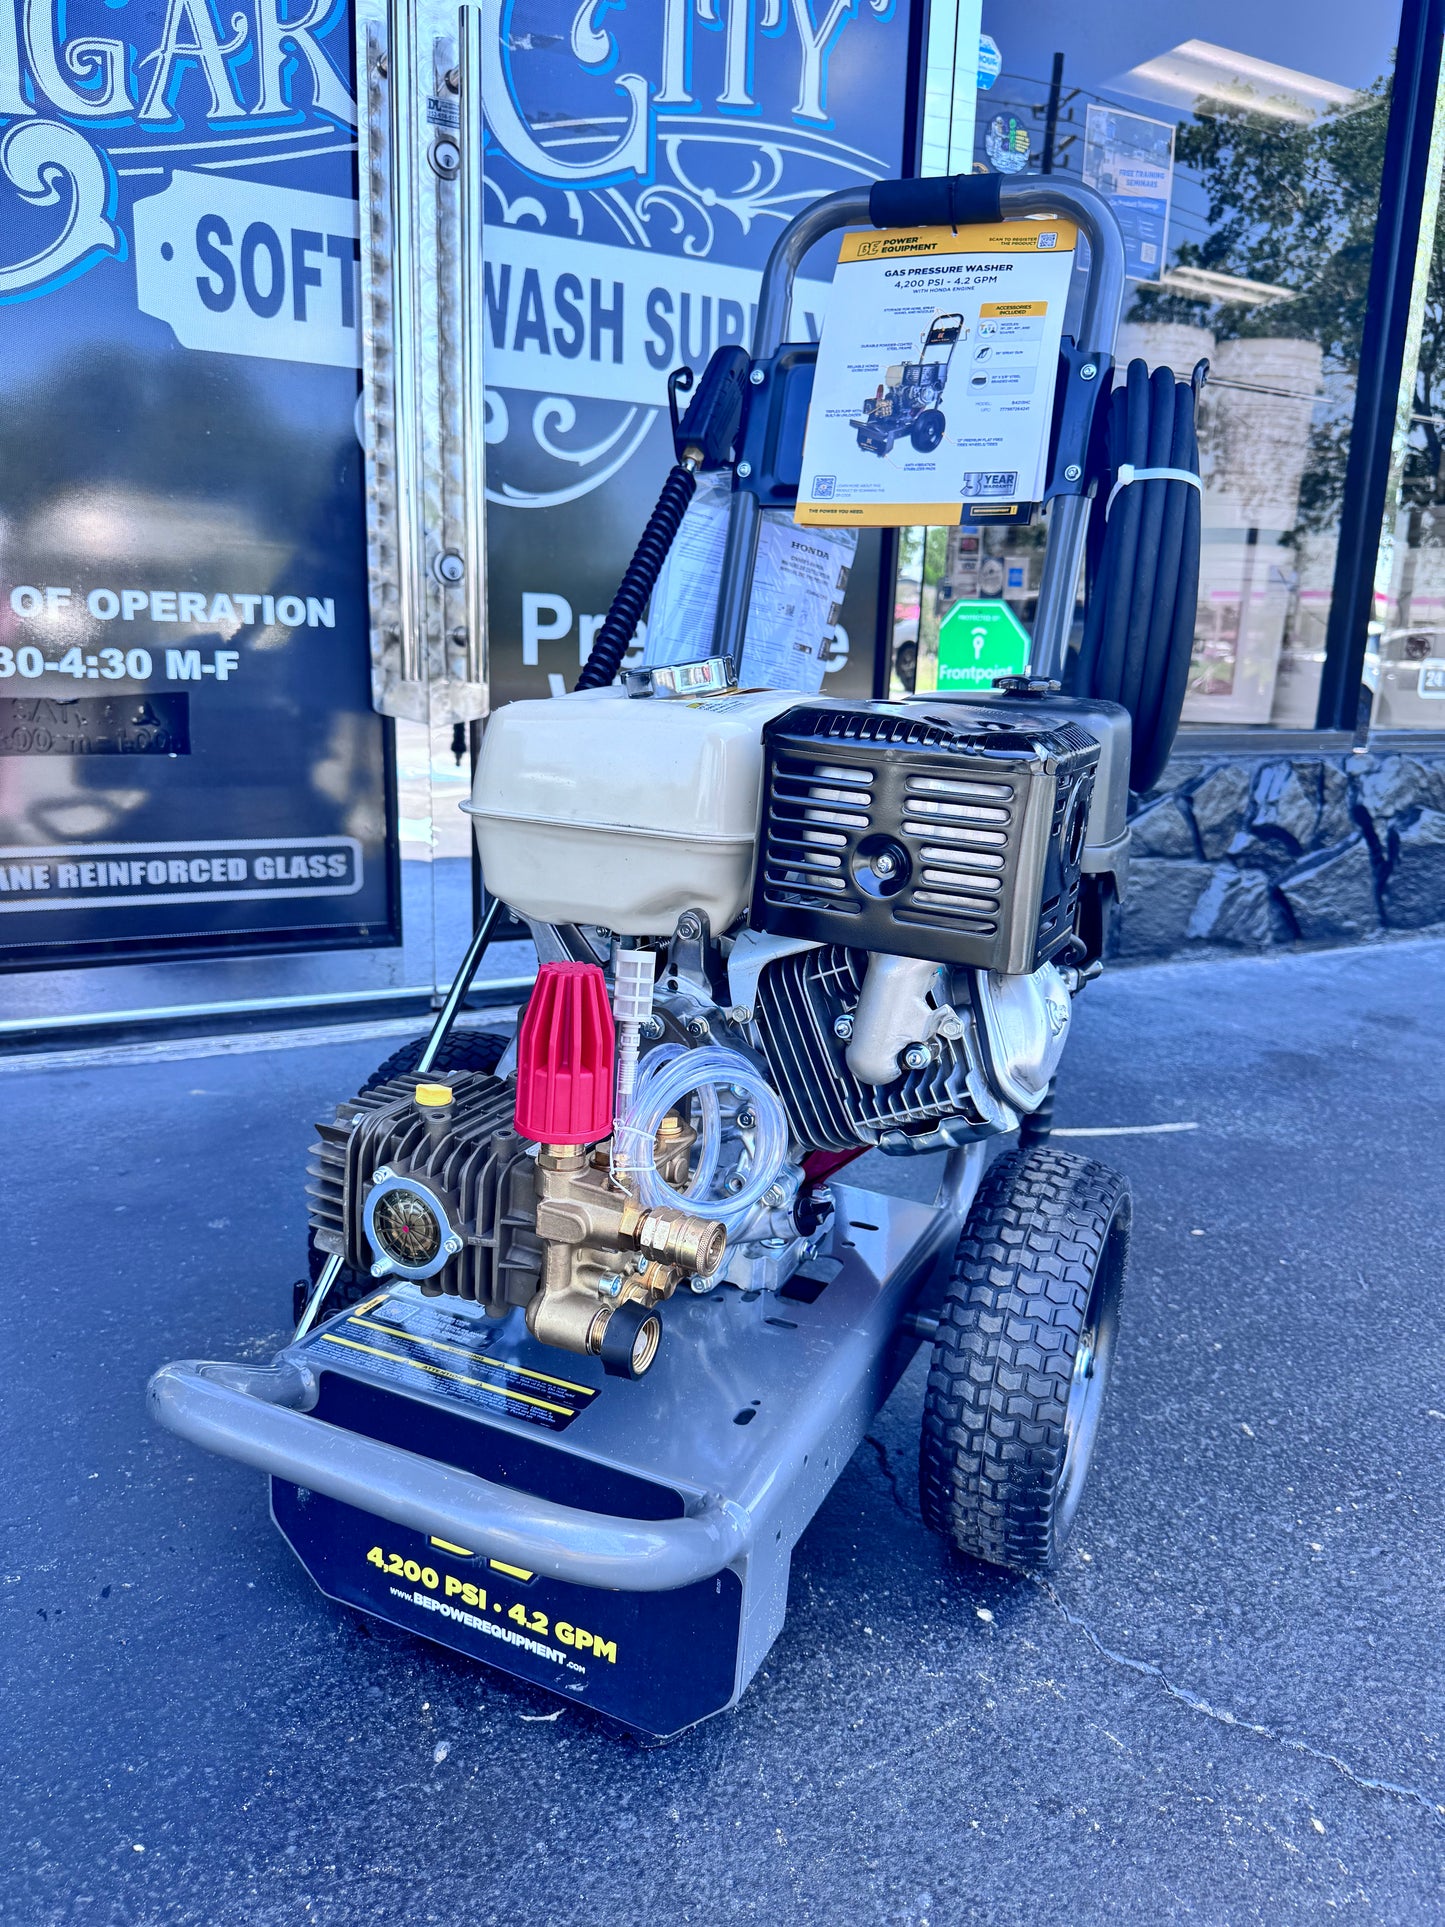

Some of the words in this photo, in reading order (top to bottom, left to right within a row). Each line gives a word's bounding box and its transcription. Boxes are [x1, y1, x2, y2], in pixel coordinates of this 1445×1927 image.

[881, 243, 938, 254] EQUIPMENT
[883, 236, 919, 246] POWER
[884, 269, 906, 278] GAS
[907, 265, 963, 277] PRESSURE
[965, 264, 1014, 273] WASHER
[894, 279, 925, 289] 4,200
[927, 278, 944, 287] PSI
[954, 277, 971, 286] 4.2
[973, 275, 998, 284] GPM
[960, 472, 983, 497] 3
[985, 474, 1014, 484] YEAR
[791, 541, 829, 560] HONDA
[10, 585, 71, 619] OF
[89, 588, 336, 628] OPERATION
[166, 649, 239, 680] M-F
[939, 664, 1013, 685] Frontpoint
[58, 858, 248, 889] REINFORCED
[254, 854, 348, 881] GLASS
[366, 1546, 439, 1590] 4,200
[445, 1575, 487, 1610] PSI
[508, 1603, 549, 1636] 4.2
[554, 1621, 617, 1664] GPM
